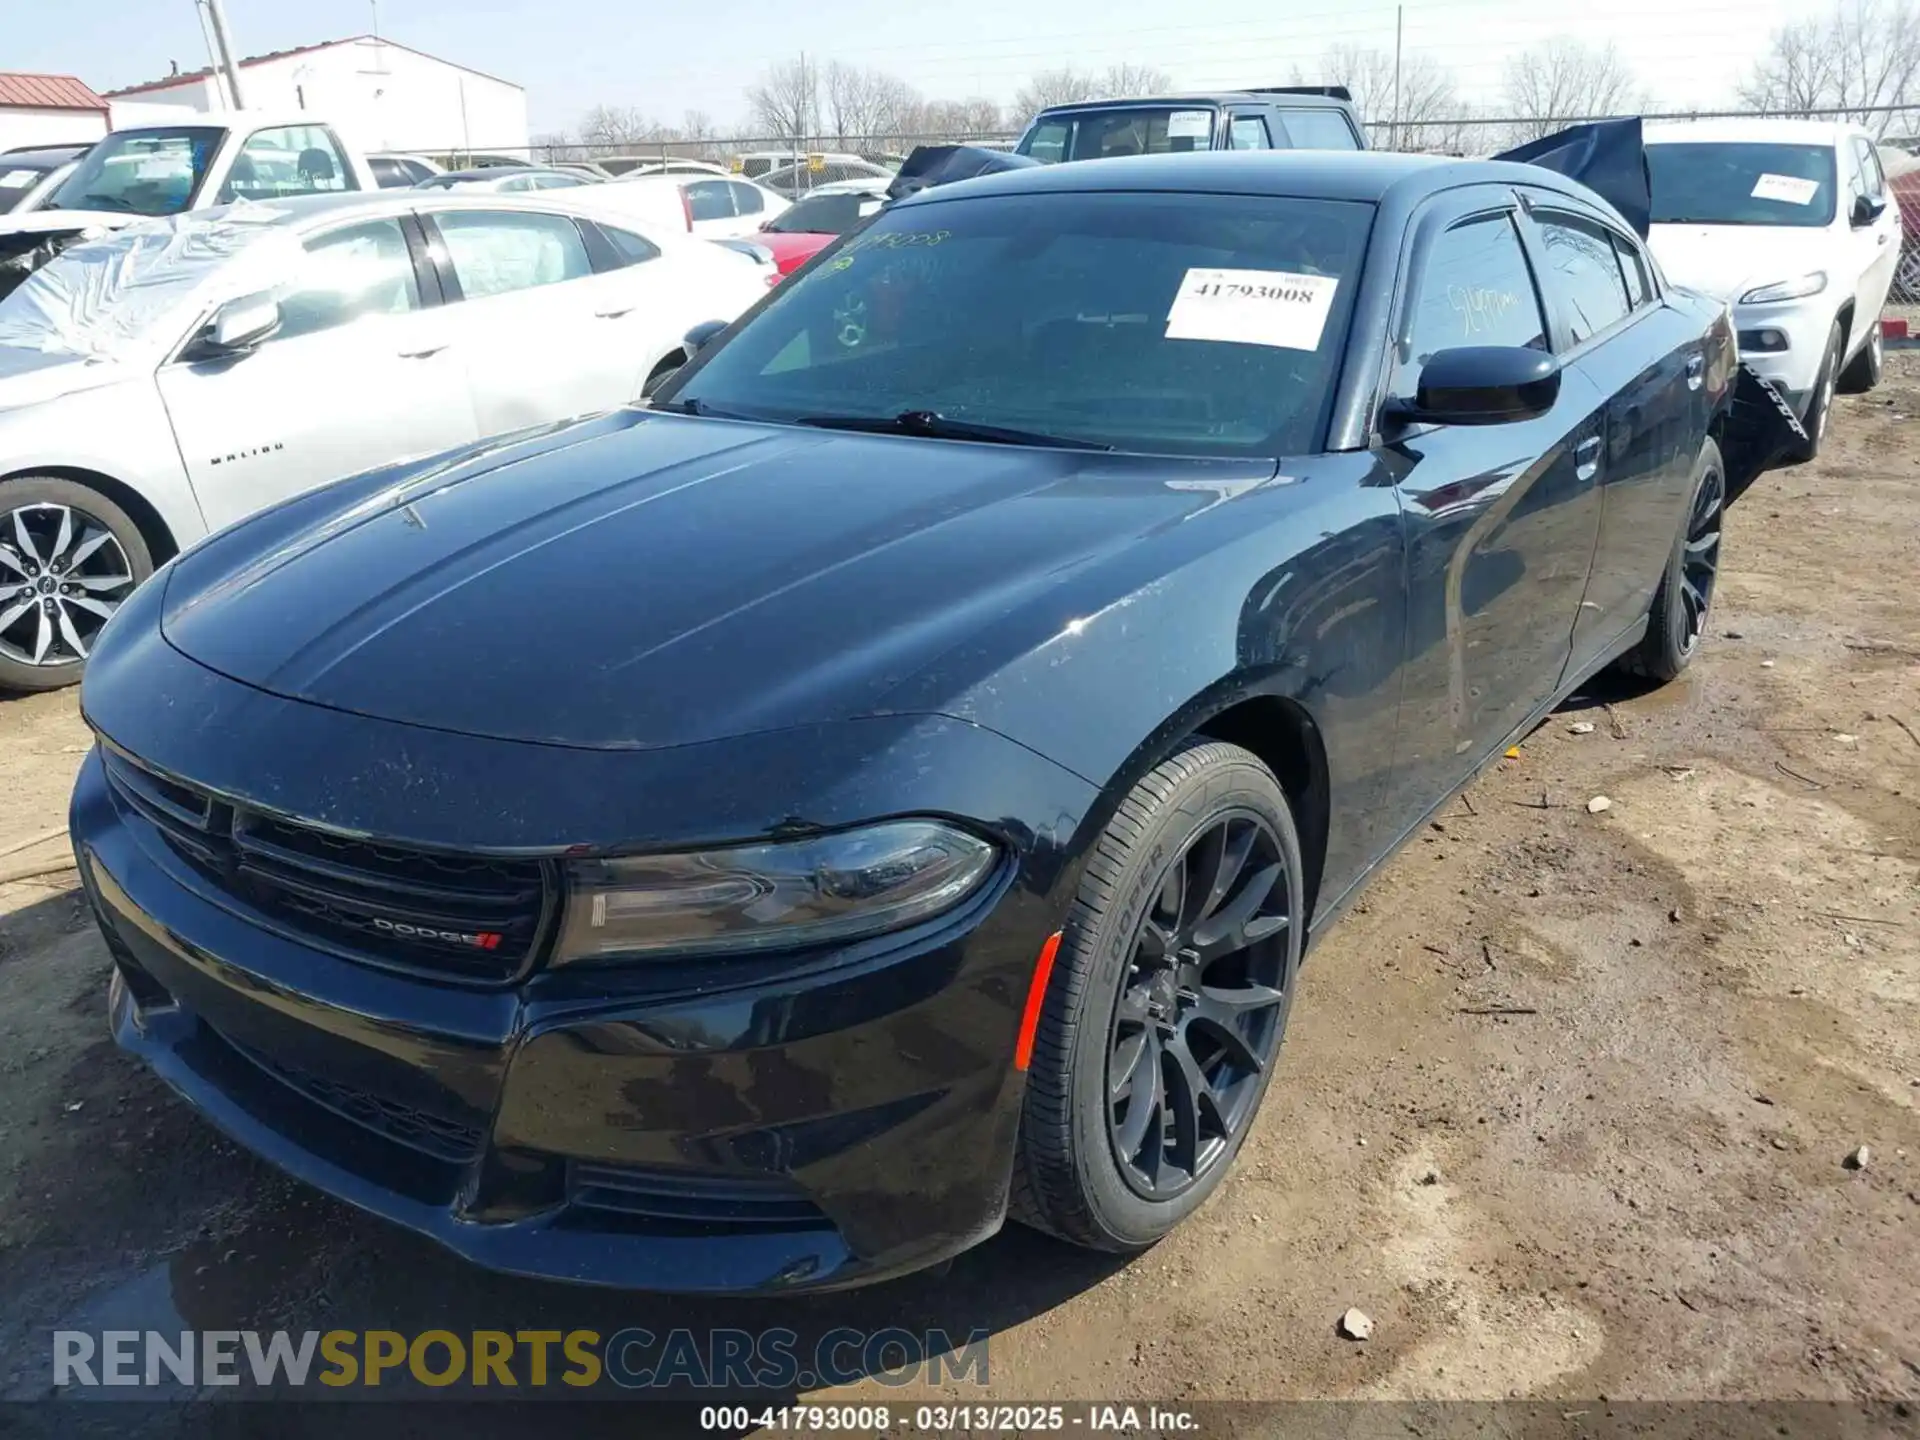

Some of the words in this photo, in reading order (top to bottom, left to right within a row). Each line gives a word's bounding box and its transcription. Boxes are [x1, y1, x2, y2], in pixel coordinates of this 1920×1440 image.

[1194, 283, 1314, 304] 41793008
[210, 442, 284, 466] MALIBU
[1103, 843, 1164, 986] COOPER
[373, 918, 486, 946] DODGE
